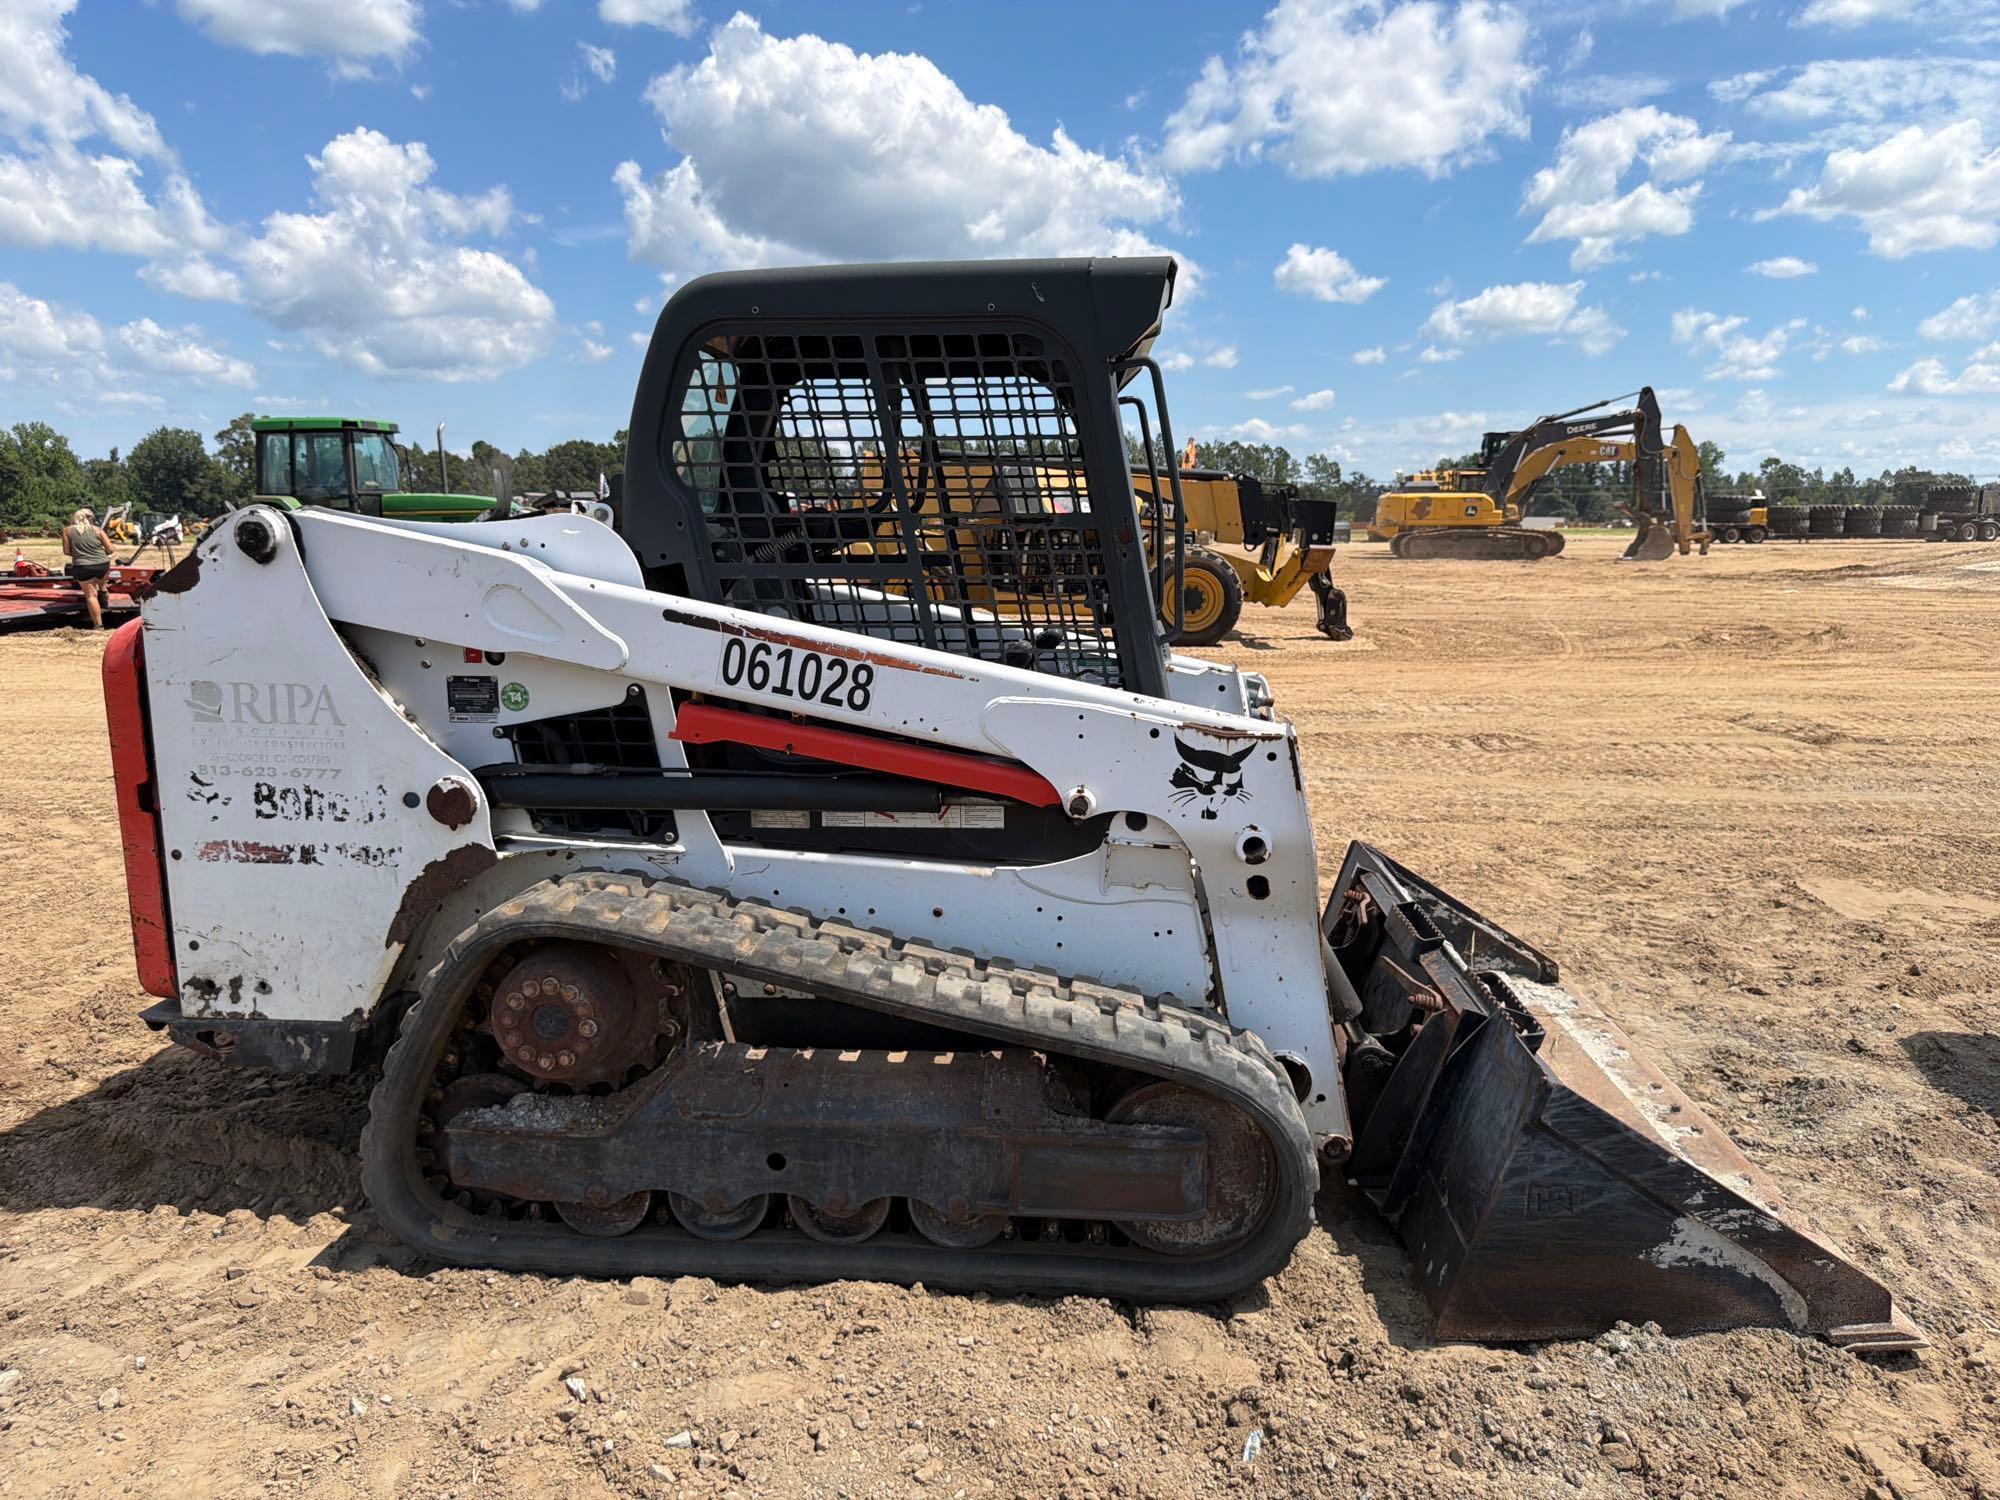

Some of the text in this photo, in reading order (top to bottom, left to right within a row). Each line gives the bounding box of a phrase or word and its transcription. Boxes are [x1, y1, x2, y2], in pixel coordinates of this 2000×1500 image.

[1600, 446, 1617, 456] CAT
[722, 637, 875, 712] 061028
[228, 681, 346, 727] RIPA
[508, 691, 522, 703] T4
[197, 764, 343, 780] 813-623-6777
